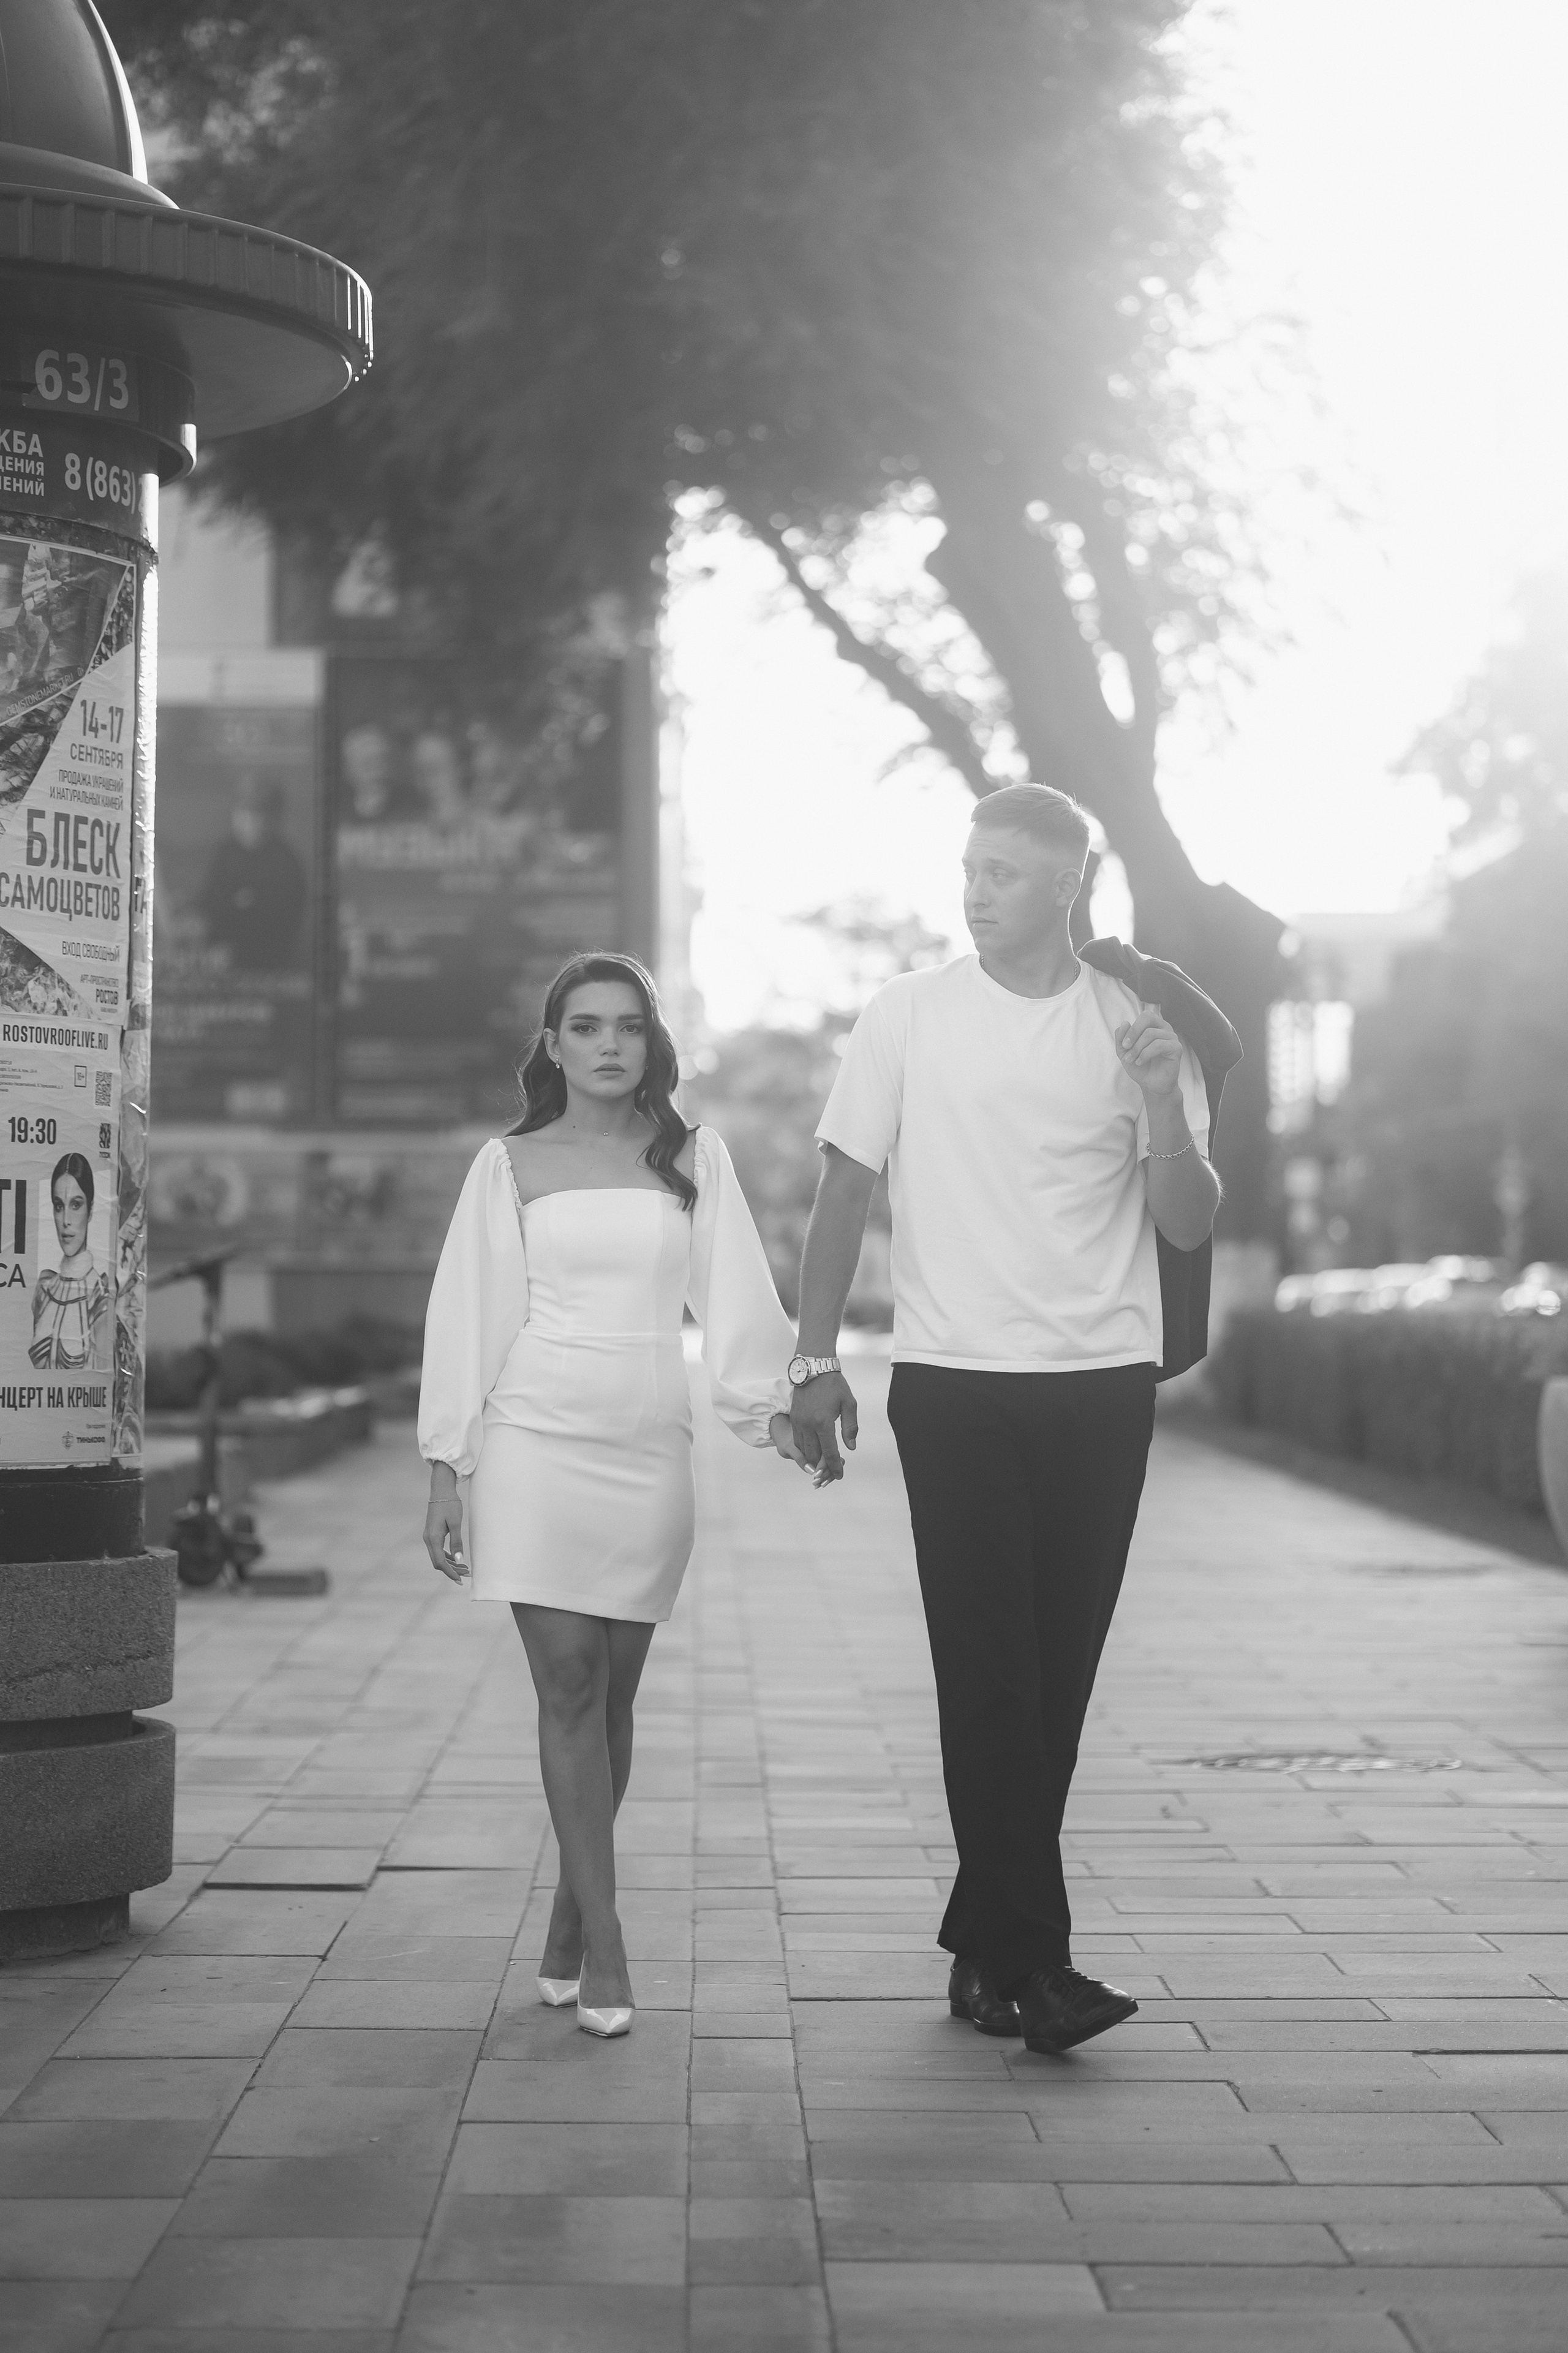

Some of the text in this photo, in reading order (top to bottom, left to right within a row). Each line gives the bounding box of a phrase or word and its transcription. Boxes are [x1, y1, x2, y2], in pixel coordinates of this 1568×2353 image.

[35, 349, 129, 411] 63/3
[0, 475, 44, 496] ЕНИЙ
[80, 700, 124, 744] 14-17
[70, 743, 123, 769] СЕНТЯБРЯ
[26, 809, 121, 878] БЛЕСК
[0, 872, 120, 921] САМОЦВЕТОВ
[3, 1024, 108, 1050] ROSTOVROOFLIVE.RU
[8, 1117, 56, 1145] 19:30
[48, 1387, 64, 1408] НА
[68, 1386, 107, 1408] КРЫШЕ
